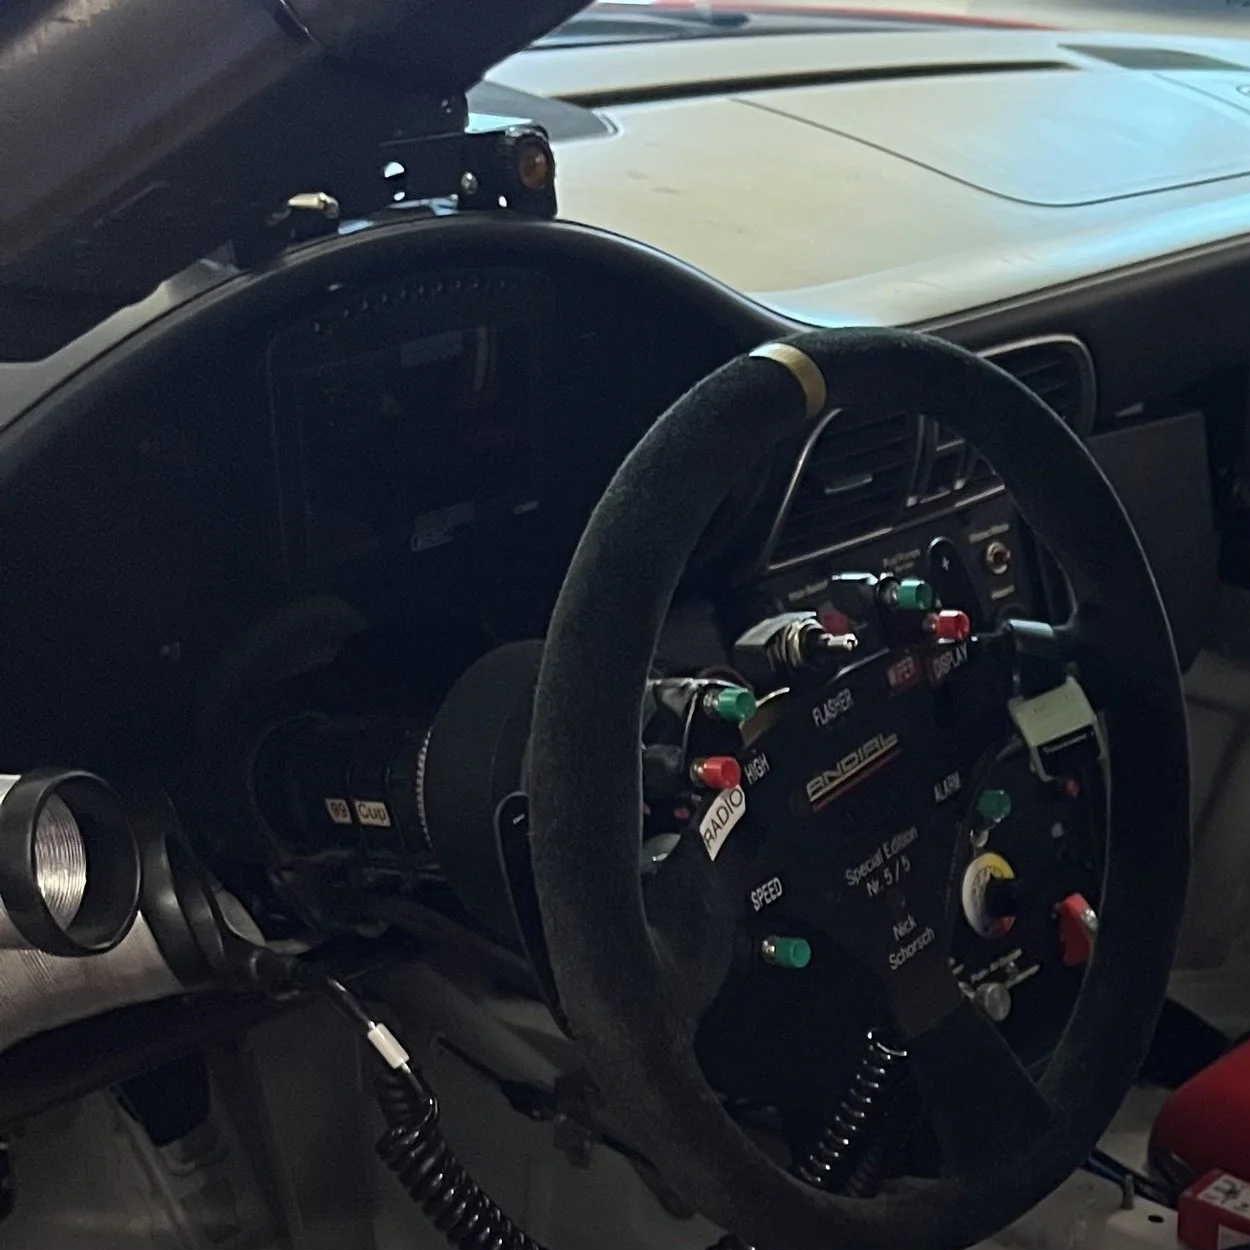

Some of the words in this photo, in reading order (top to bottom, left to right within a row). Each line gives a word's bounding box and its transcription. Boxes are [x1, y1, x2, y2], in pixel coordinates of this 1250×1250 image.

[812, 687, 854, 728] FLASHER
[744, 753, 770, 785] HIGH
[806, 732, 899, 801] ANDIAL
[933, 771, 963, 804] ALARM
[359, 803, 386, 824] Cup
[703, 787, 743, 850] RADIO
[845, 848, 884, 887] Special
[882, 826, 919, 860] Edition
[751, 876, 784, 912] SPEED
[892, 914, 918, 941] Nick
